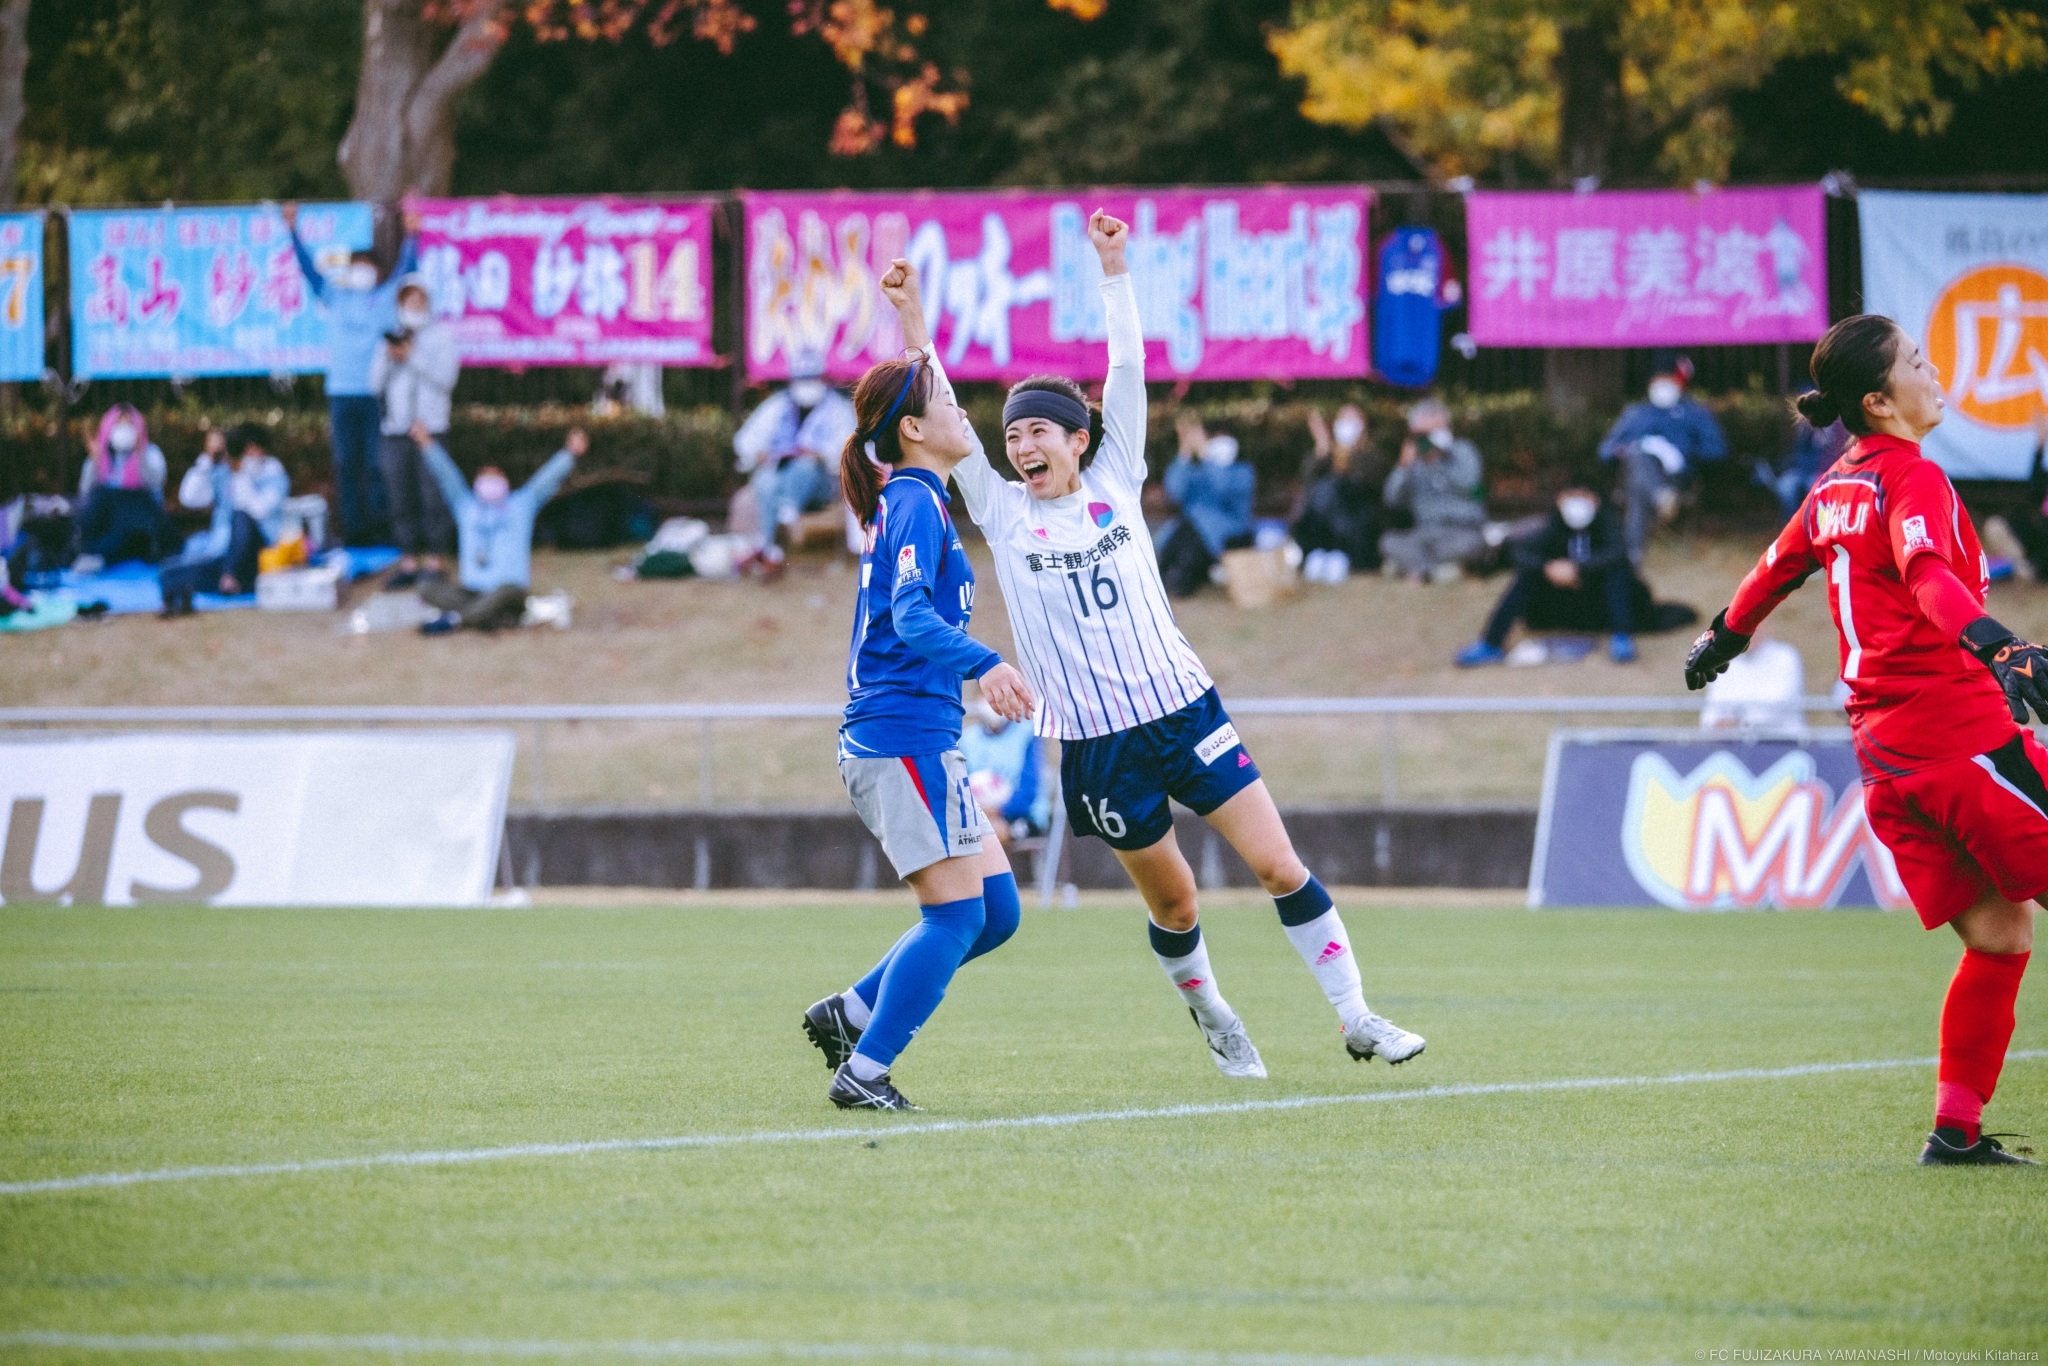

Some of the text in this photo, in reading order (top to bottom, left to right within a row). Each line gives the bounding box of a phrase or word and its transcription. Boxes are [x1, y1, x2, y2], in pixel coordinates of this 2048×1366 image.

[624, 238, 706, 323] 14
[1481, 225, 1766, 303] 井原美波
[1025, 524, 1132, 573] 富士観光開発
[1067, 563, 1119, 618] 16
[1831, 543, 1862, 679] 1
[1082, 793, 1127, 839] 16
